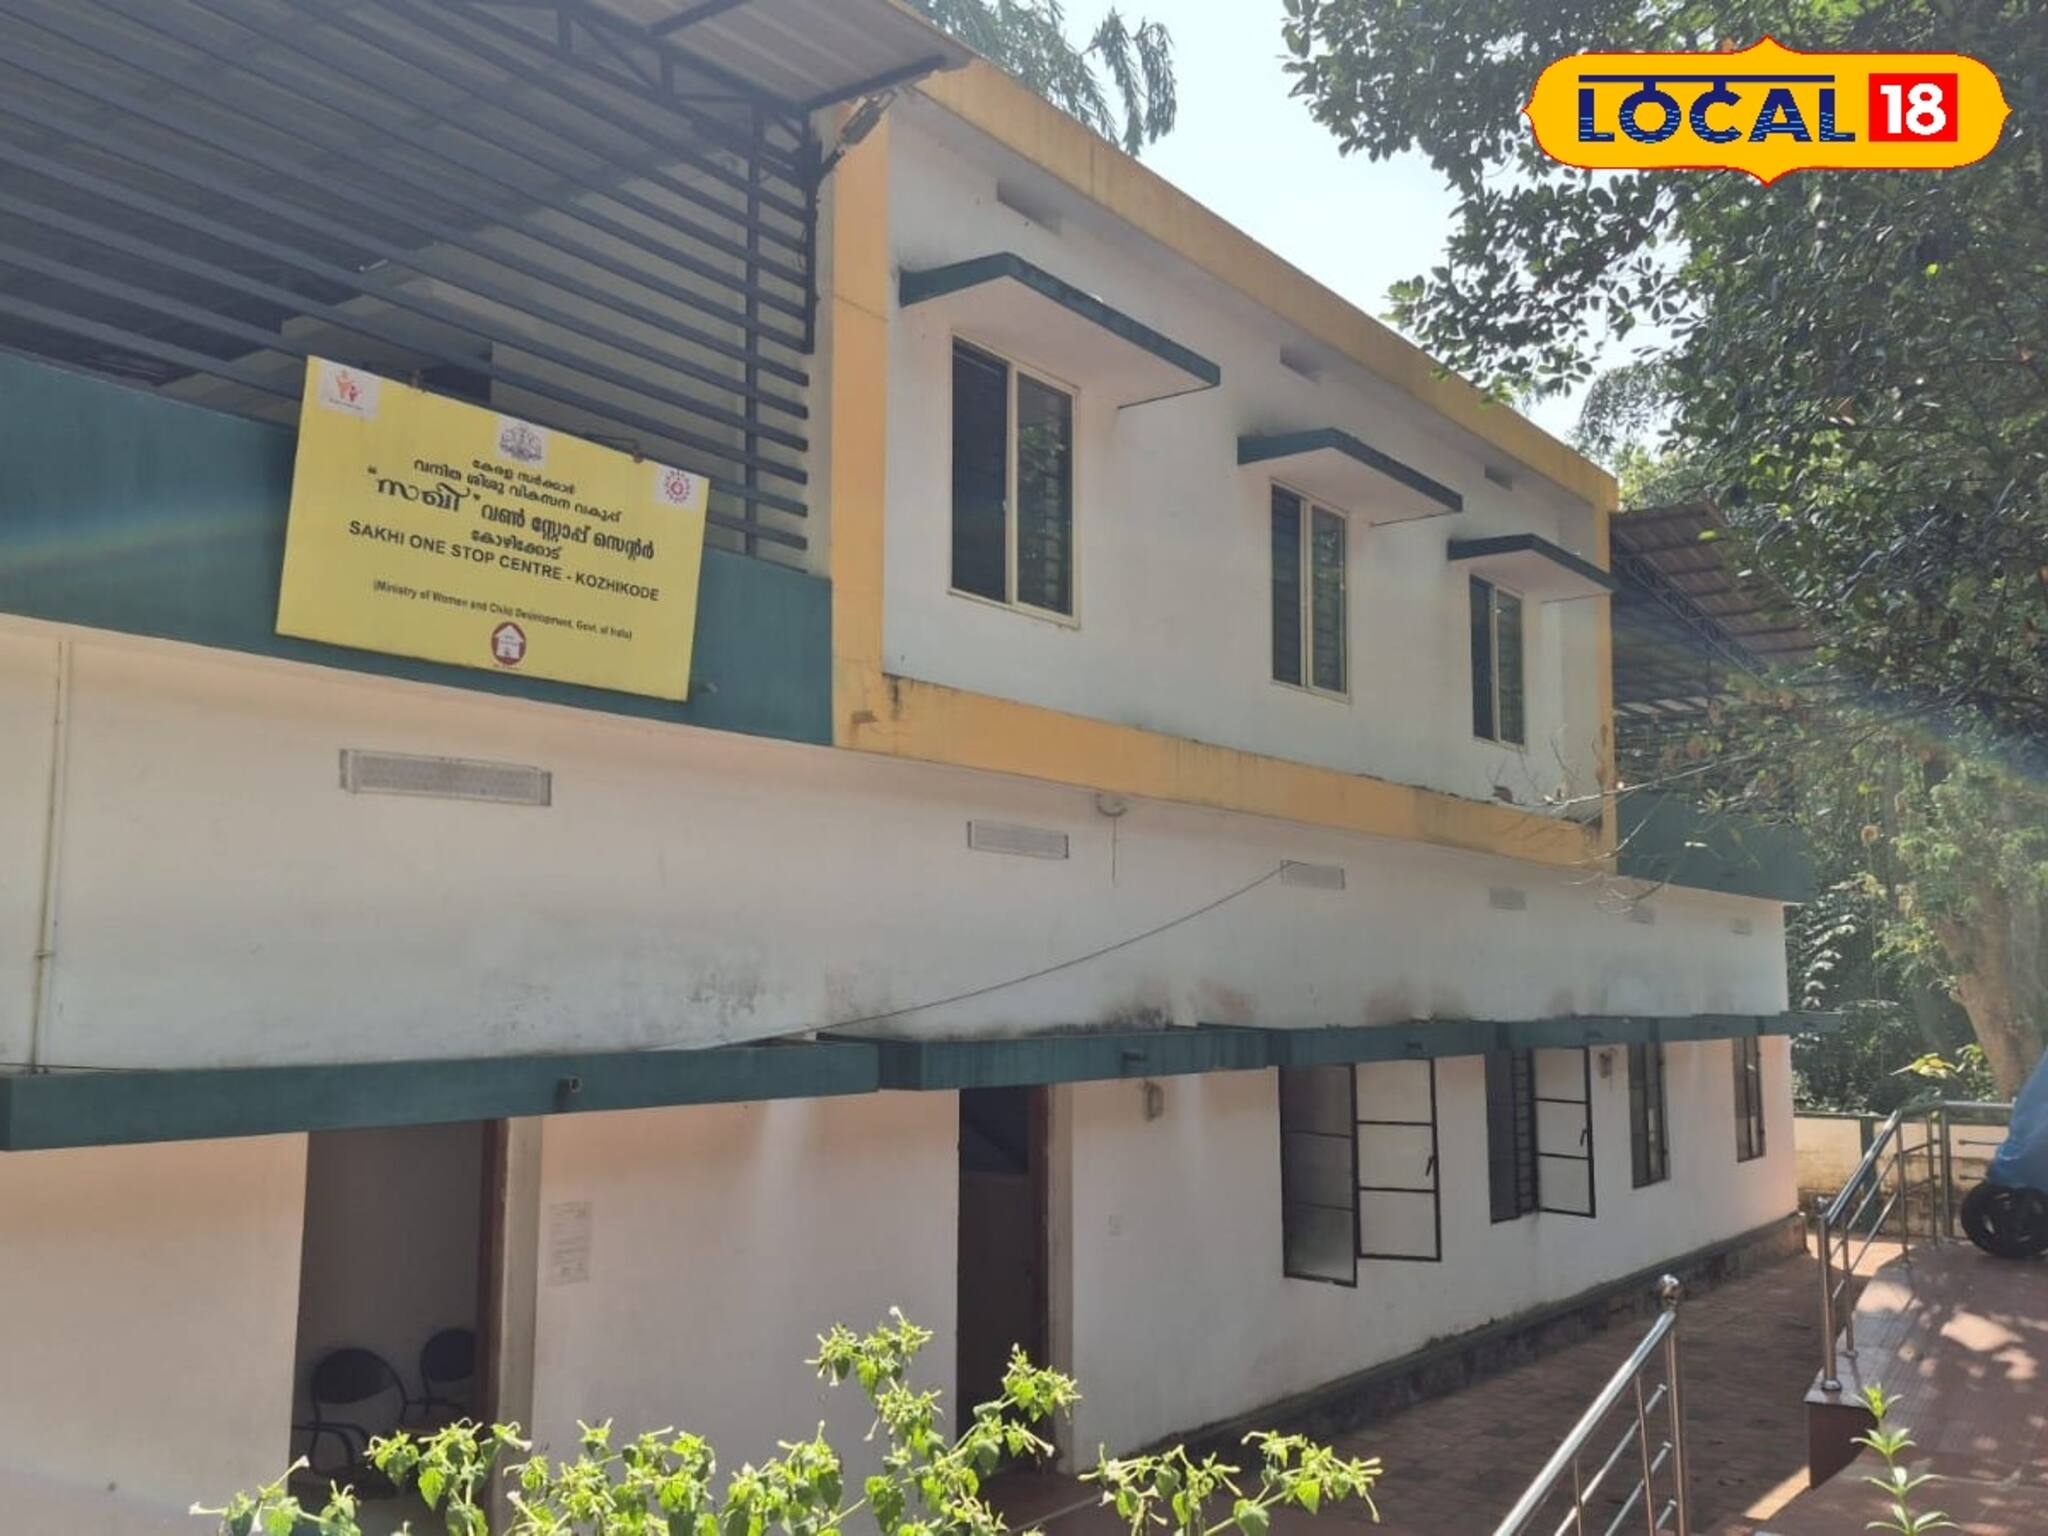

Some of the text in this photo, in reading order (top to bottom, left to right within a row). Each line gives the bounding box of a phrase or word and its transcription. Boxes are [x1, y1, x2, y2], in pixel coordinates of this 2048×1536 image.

[414, 459, 461, 481] വനിത
[349, 520, 405, 545] SAKHI
[409, 534, 446, 554] ONE
[450, 544, 495, 564] STOP
[499, 554, 563, 581] CENTRE
[575, 572, 660, 601] KOZHIKODE
[420, 589, 430, 600] of
[432, 591, 468, 607] Women
[470, 600, 487, 612] and
